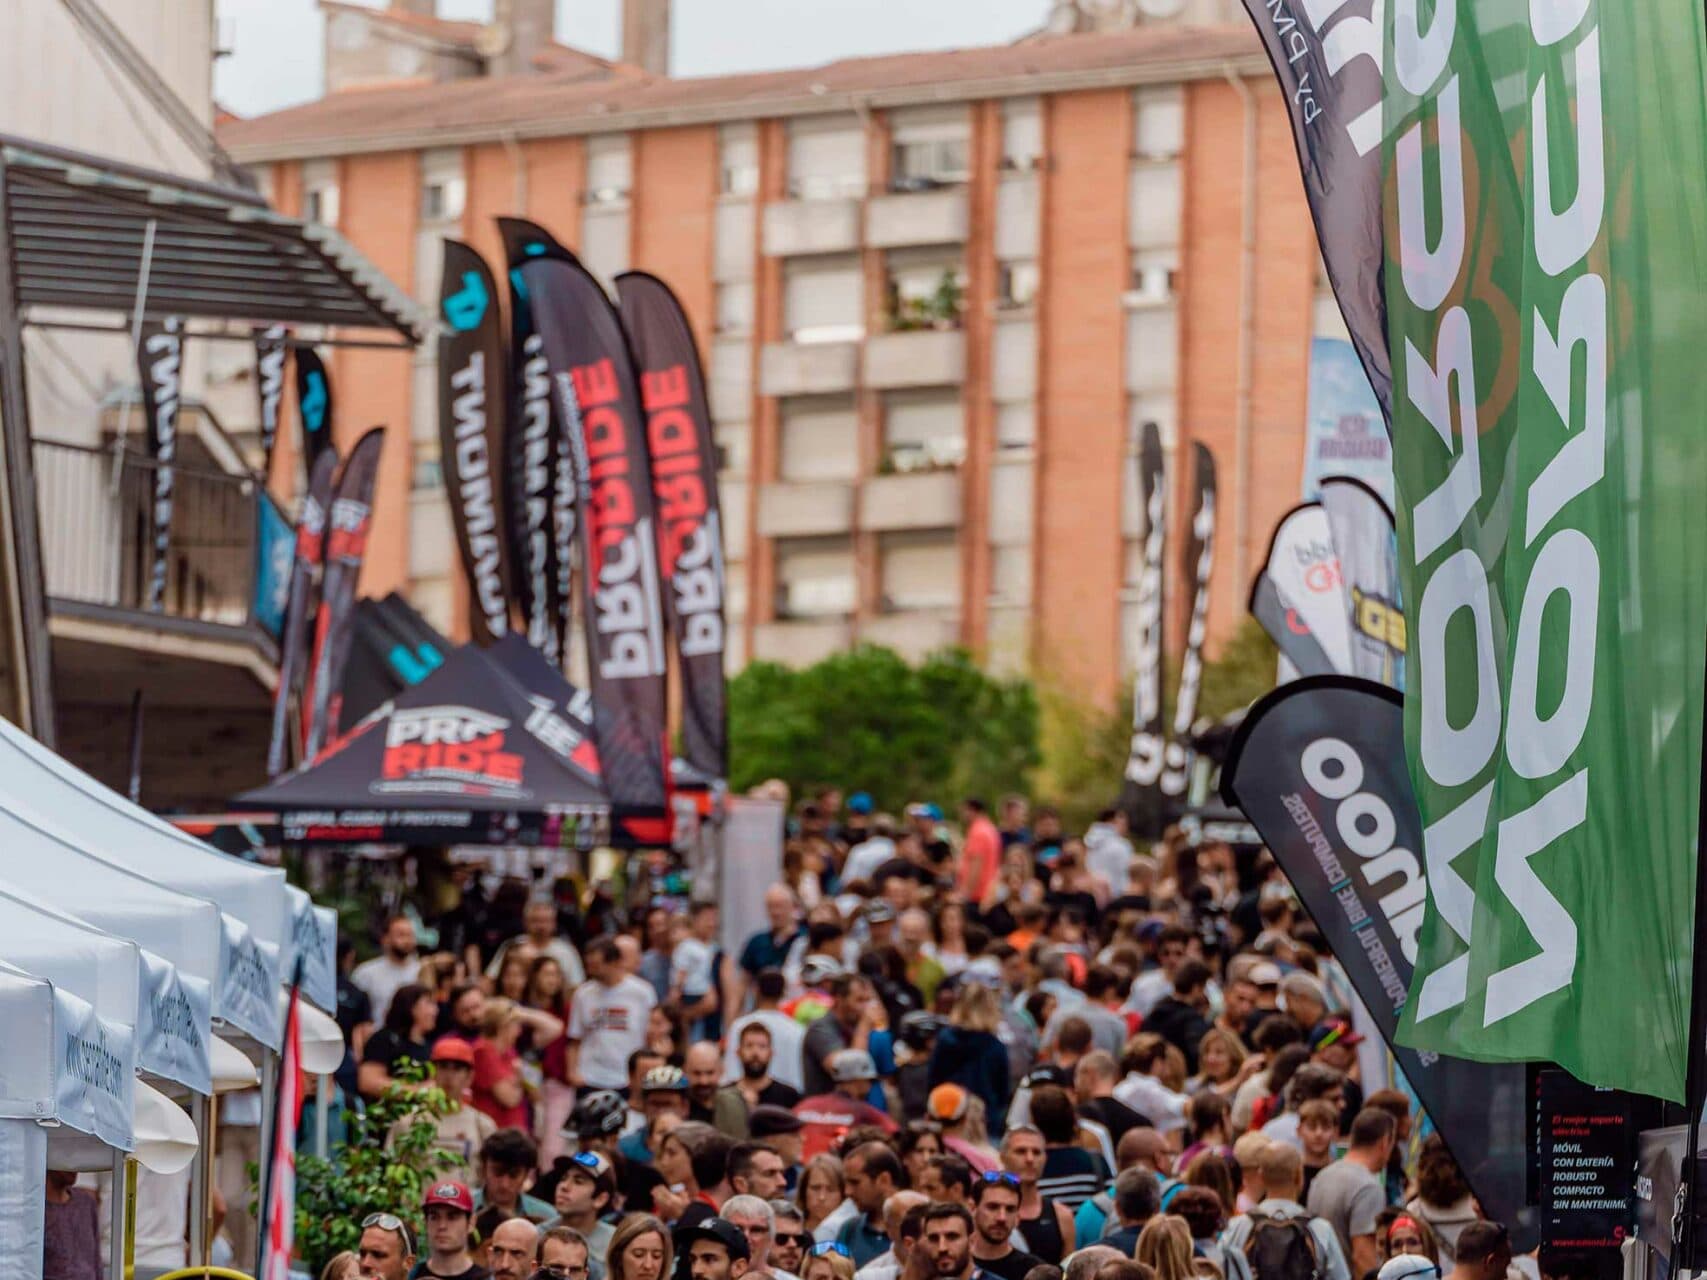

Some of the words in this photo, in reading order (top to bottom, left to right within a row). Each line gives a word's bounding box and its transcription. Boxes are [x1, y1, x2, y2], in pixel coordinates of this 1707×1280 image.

[1552, 1142, 1582, 1153] MÓVIL
[1553, 1158, 1573, 1167] CON
[1576, 1155, 1614, 1167] BATERÍA
[1553, 1172, 1597, 1181] ROBUSTO
[1553, 1186, 1605, 1196] COMPACTO
[1553, 1200, 1568, 1209] SIN
